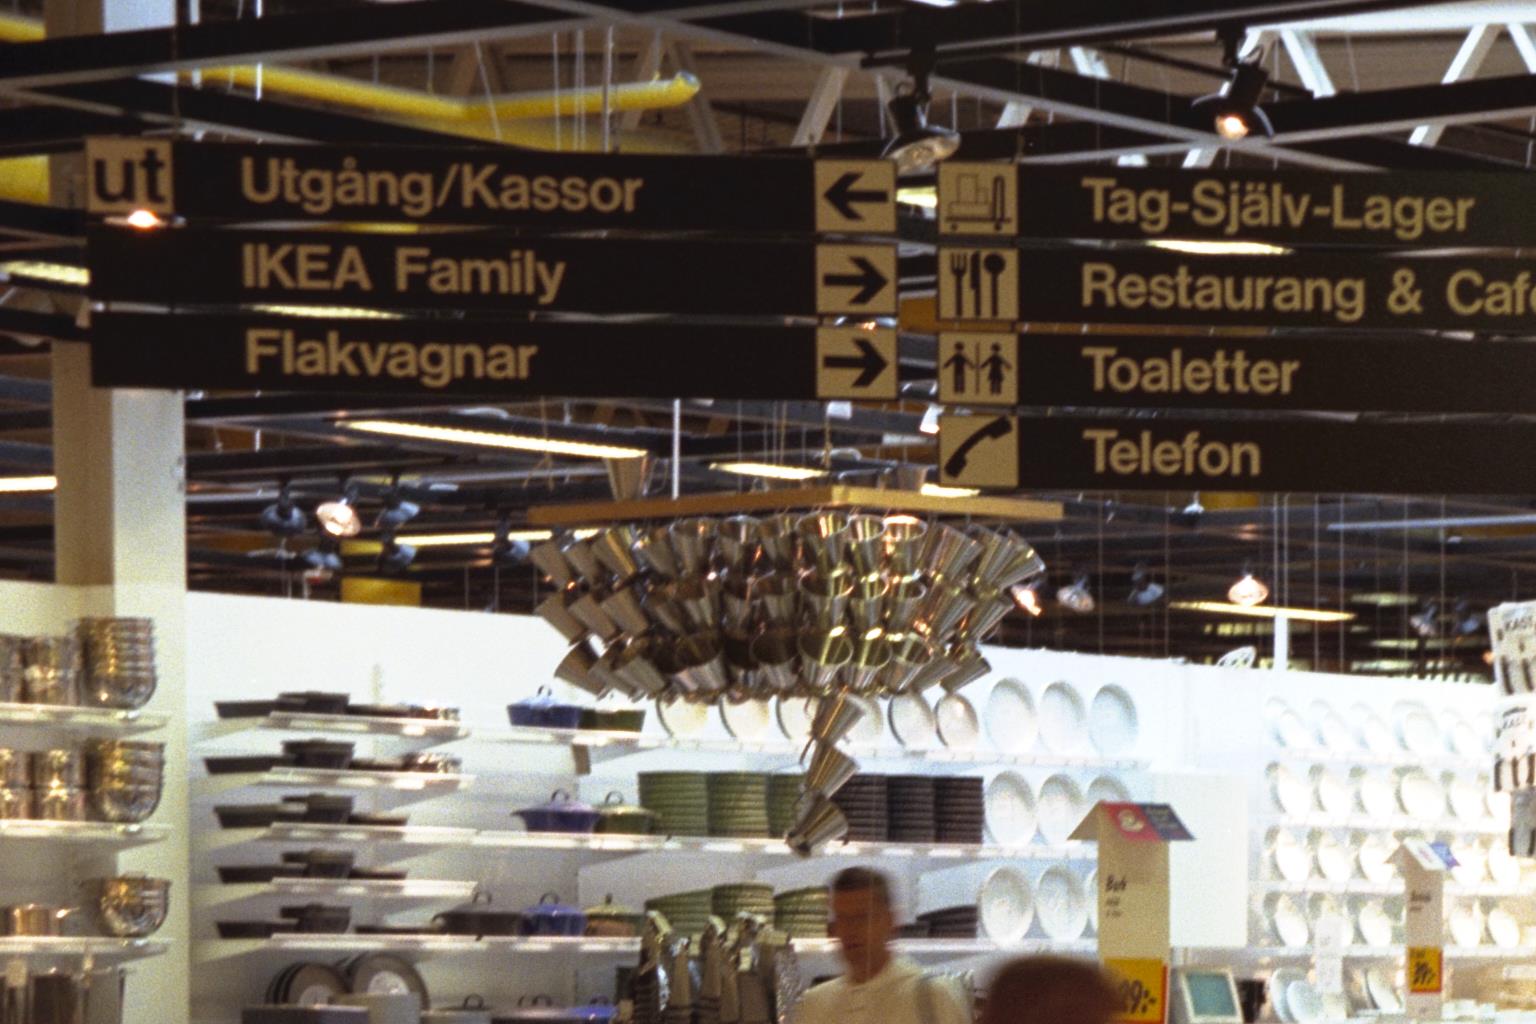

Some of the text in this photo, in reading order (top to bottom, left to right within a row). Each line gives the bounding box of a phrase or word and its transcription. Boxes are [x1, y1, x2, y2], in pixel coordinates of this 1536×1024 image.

[241, 157, 644, 216] Utgång/Kassor
[1081, 177, 1476, 240] Tag-Själv-Lager
[242, 243, 566, 304] IKEA Family
[1081, 262, 1365, 322] Restaurang
[1387, 267, 1423, 315] &
[245, 328, 538, 388] Flakvagnar
[1081, 347, 1299, 394] Toaletter
[1082, 430, 1262, 477] Telefon
